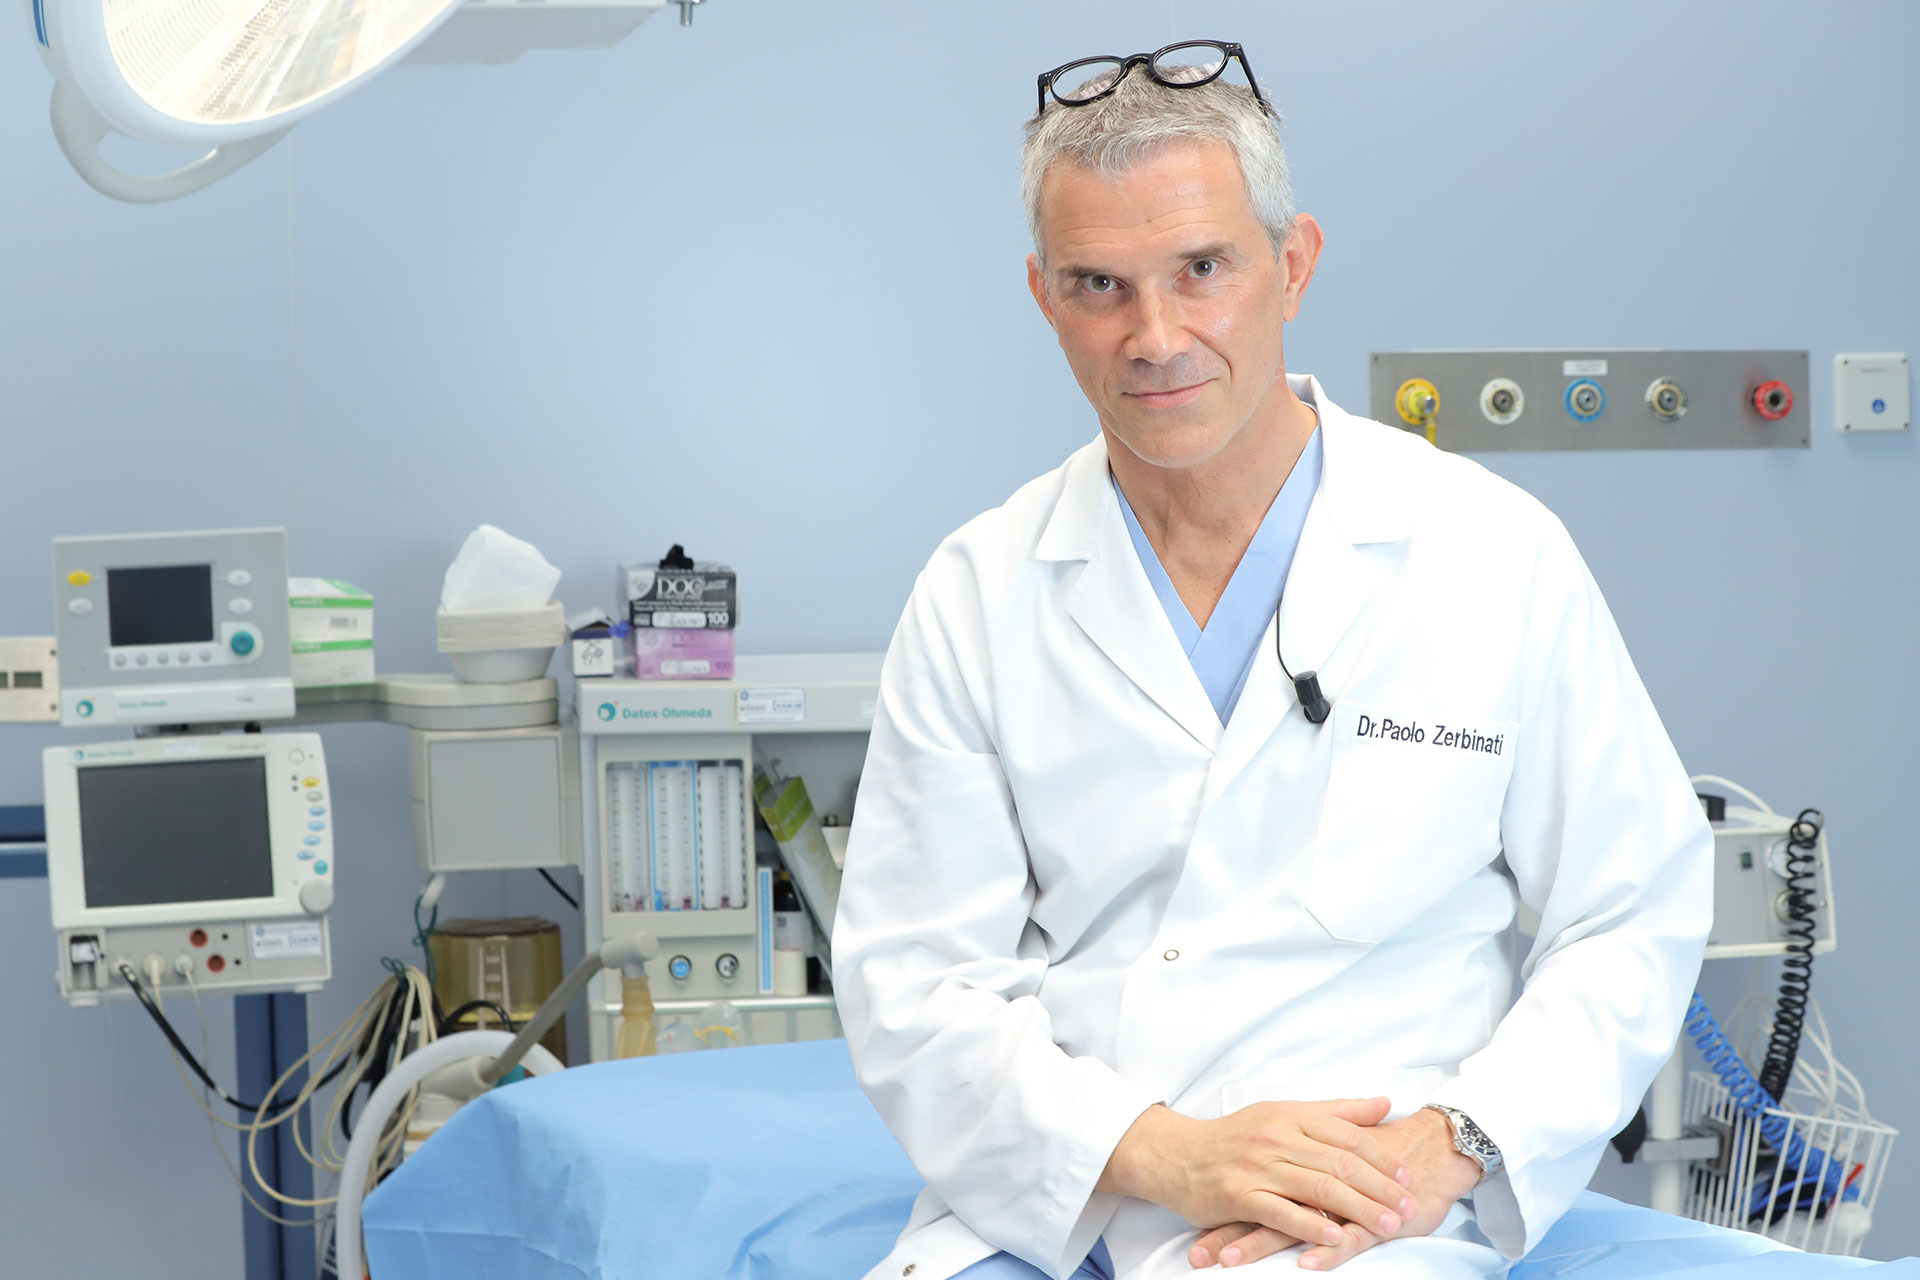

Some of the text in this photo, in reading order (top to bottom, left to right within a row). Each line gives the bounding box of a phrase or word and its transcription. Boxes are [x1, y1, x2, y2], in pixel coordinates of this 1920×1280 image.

[707, 612, 729, 625] 100
[1356, 714, 1504, 756] Dr.Paolo Zerbinati
